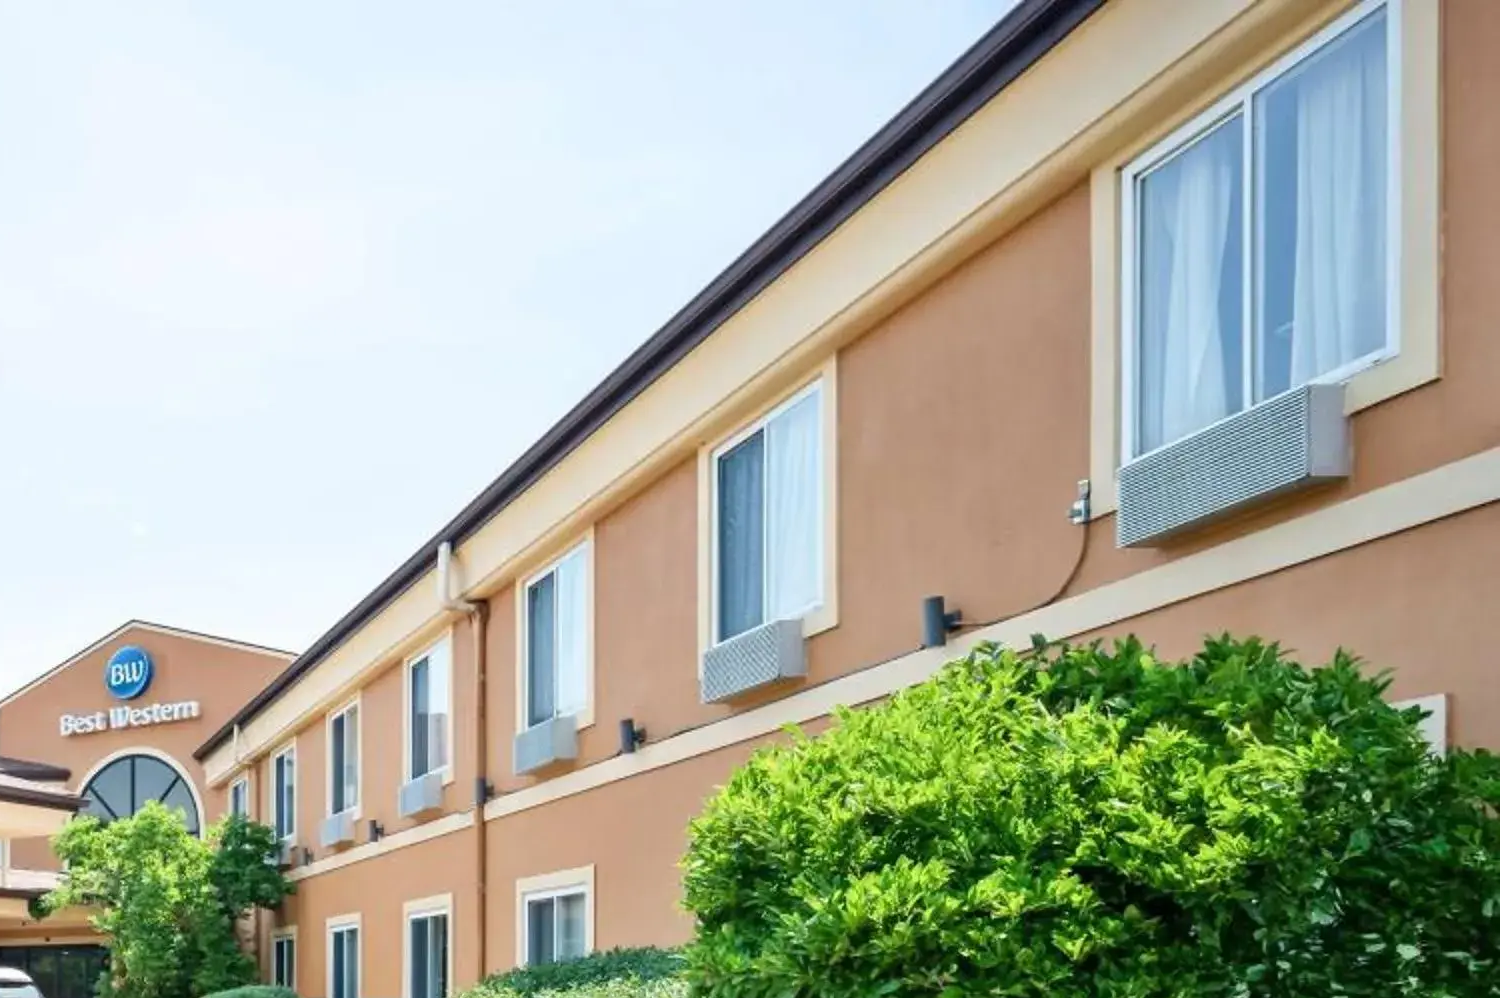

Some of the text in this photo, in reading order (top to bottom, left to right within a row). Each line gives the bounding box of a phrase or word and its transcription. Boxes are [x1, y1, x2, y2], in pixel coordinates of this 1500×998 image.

[110, 660, 143, 686] BW
[60, 700, 200, 736] Best Western
